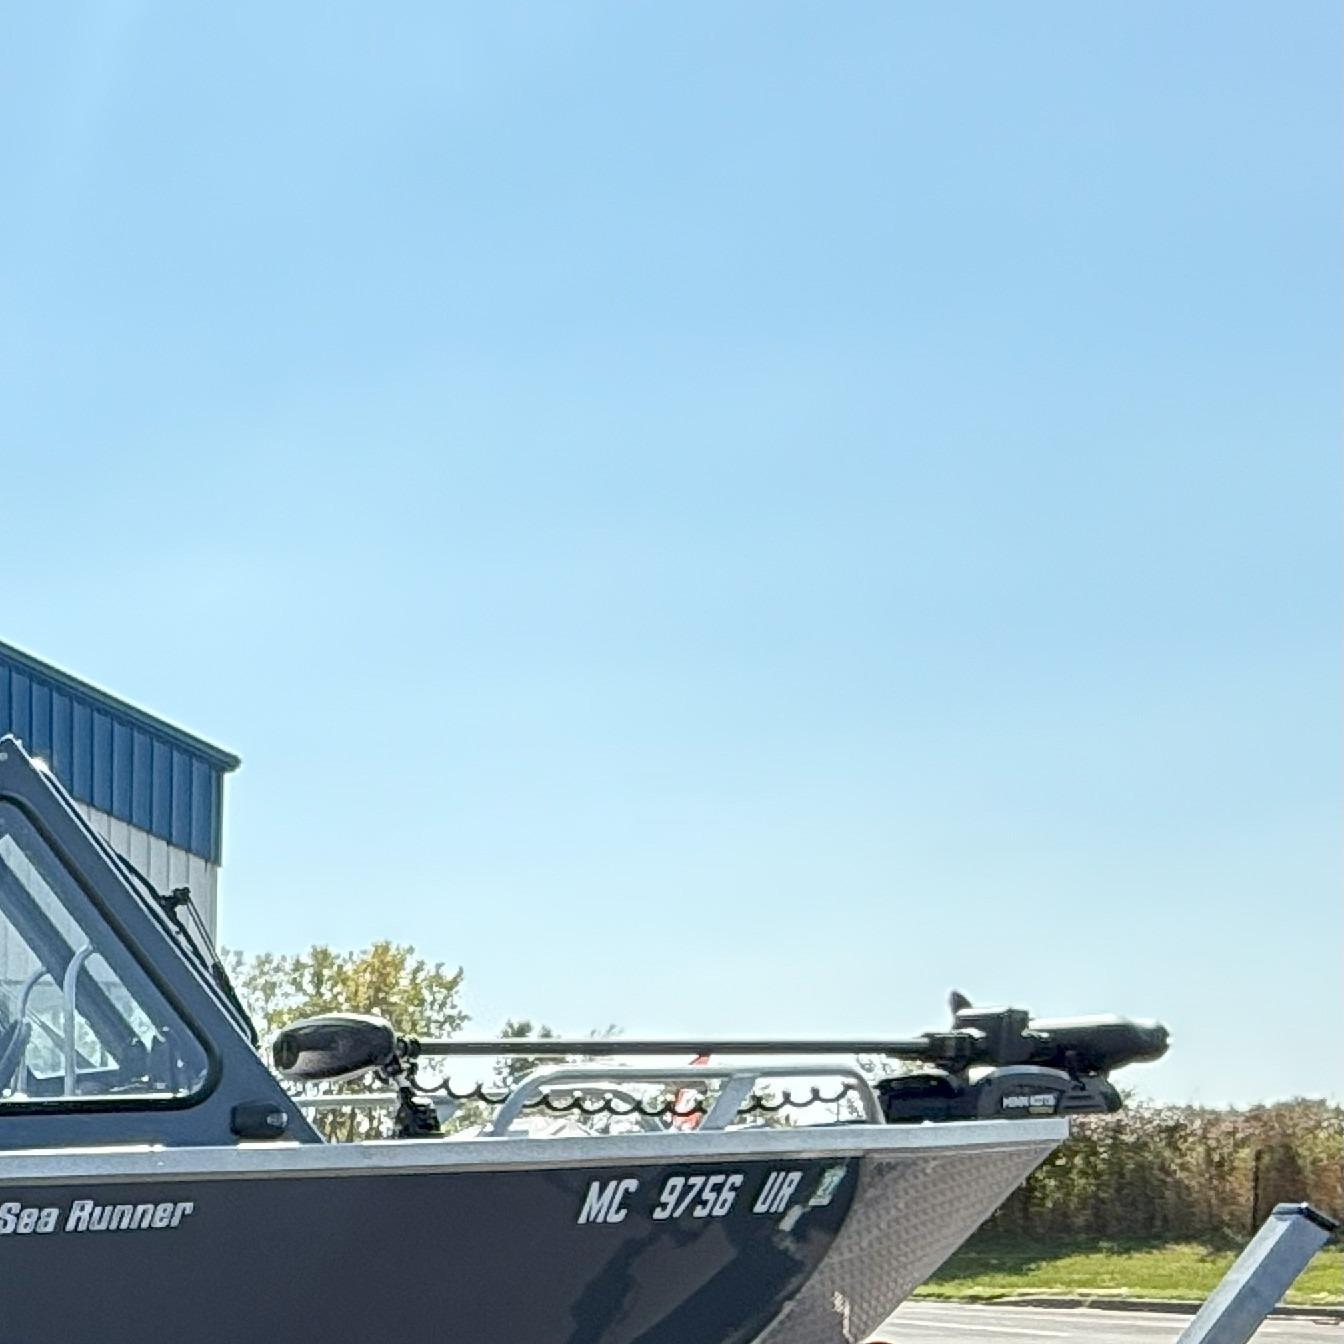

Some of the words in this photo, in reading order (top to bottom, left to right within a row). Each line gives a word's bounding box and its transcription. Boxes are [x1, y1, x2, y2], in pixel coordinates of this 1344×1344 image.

[64, 1199, 194, 1233] Runner
[577, 1178, 640, 1224] MC
[652, 1174, 744, 1220] 9756
[753, 1170, 803, 1214] UR
